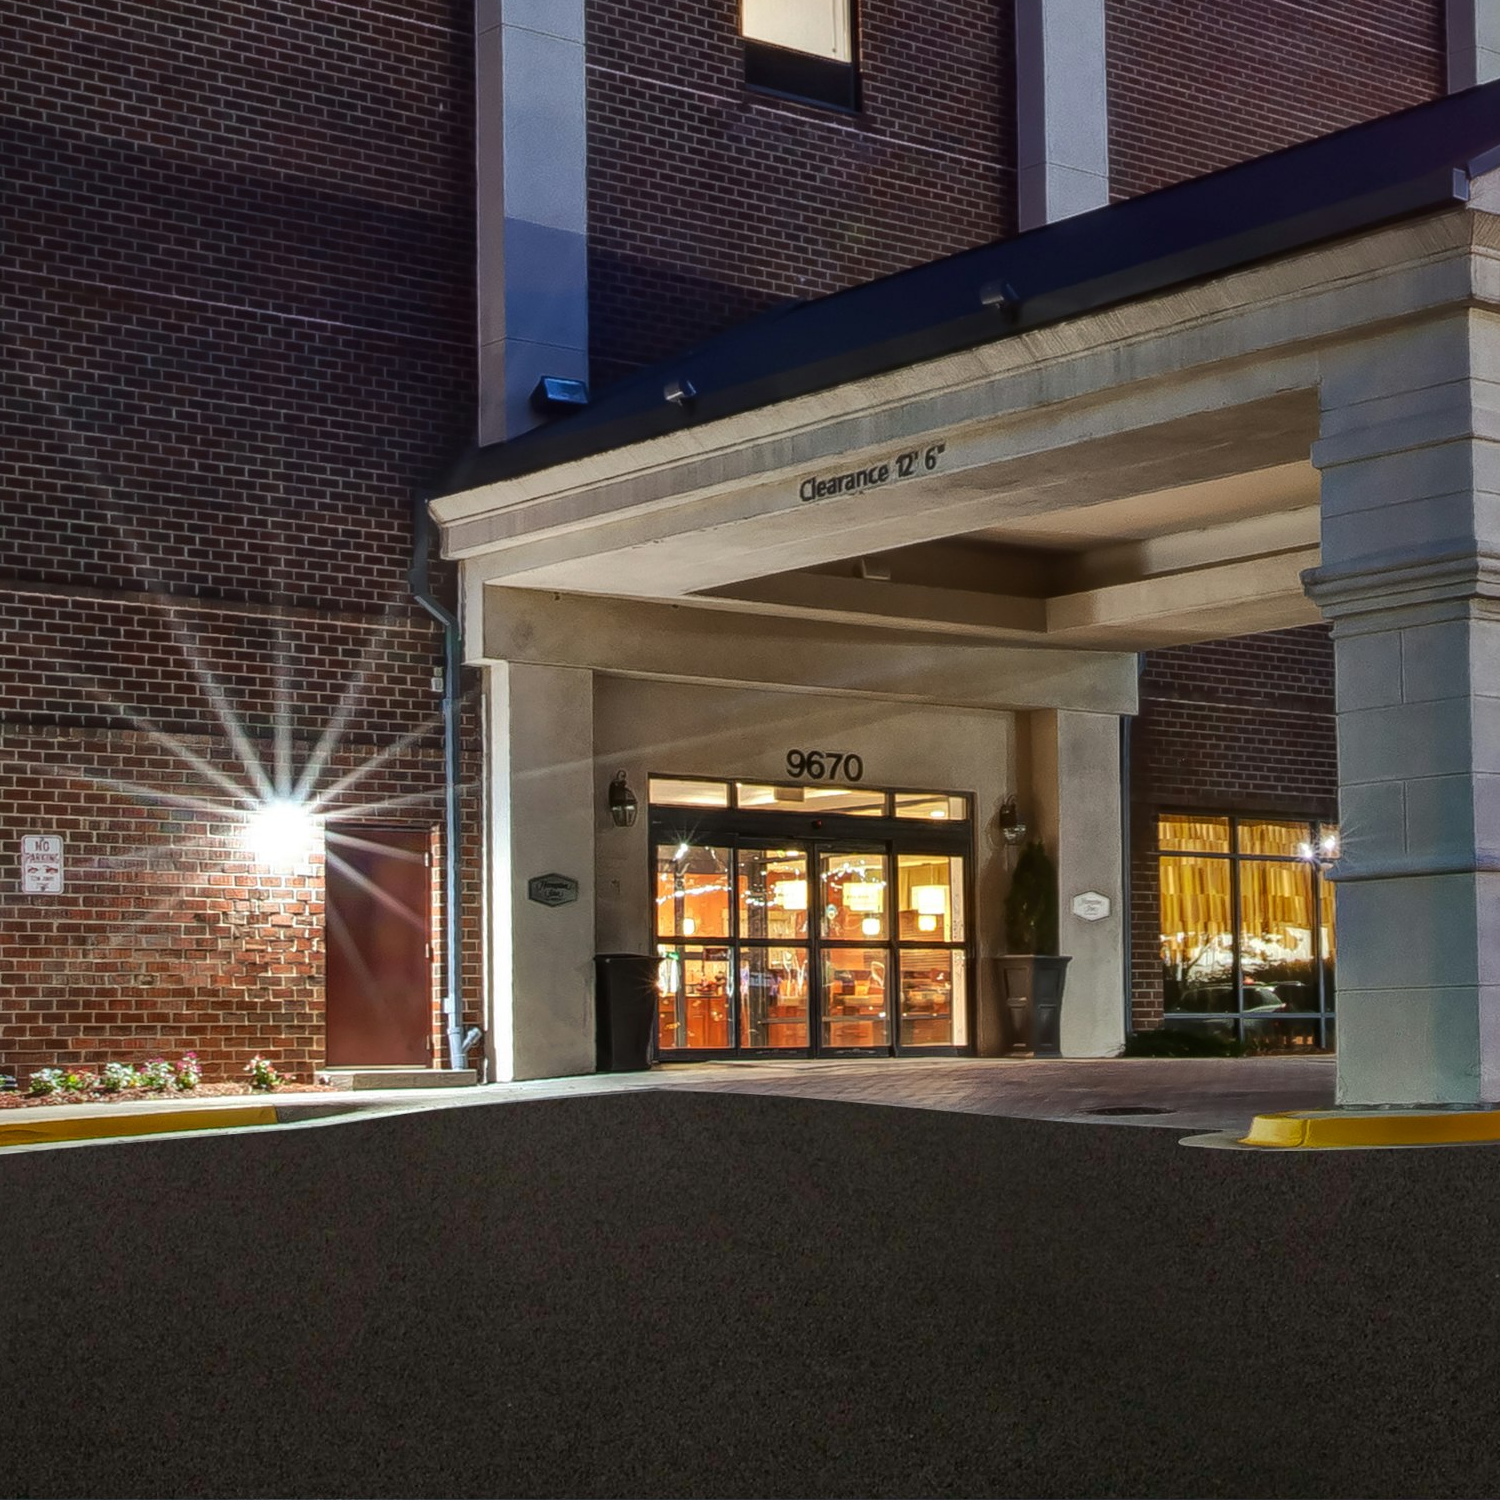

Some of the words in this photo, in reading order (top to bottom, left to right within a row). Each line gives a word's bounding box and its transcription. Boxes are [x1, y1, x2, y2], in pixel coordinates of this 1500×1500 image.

[800, 463, 889, 501] Clearance
[896, 451, 919, 477] 12'
[786, 749, 864, 782] 9670
[35, 841, 50, 851] NO
